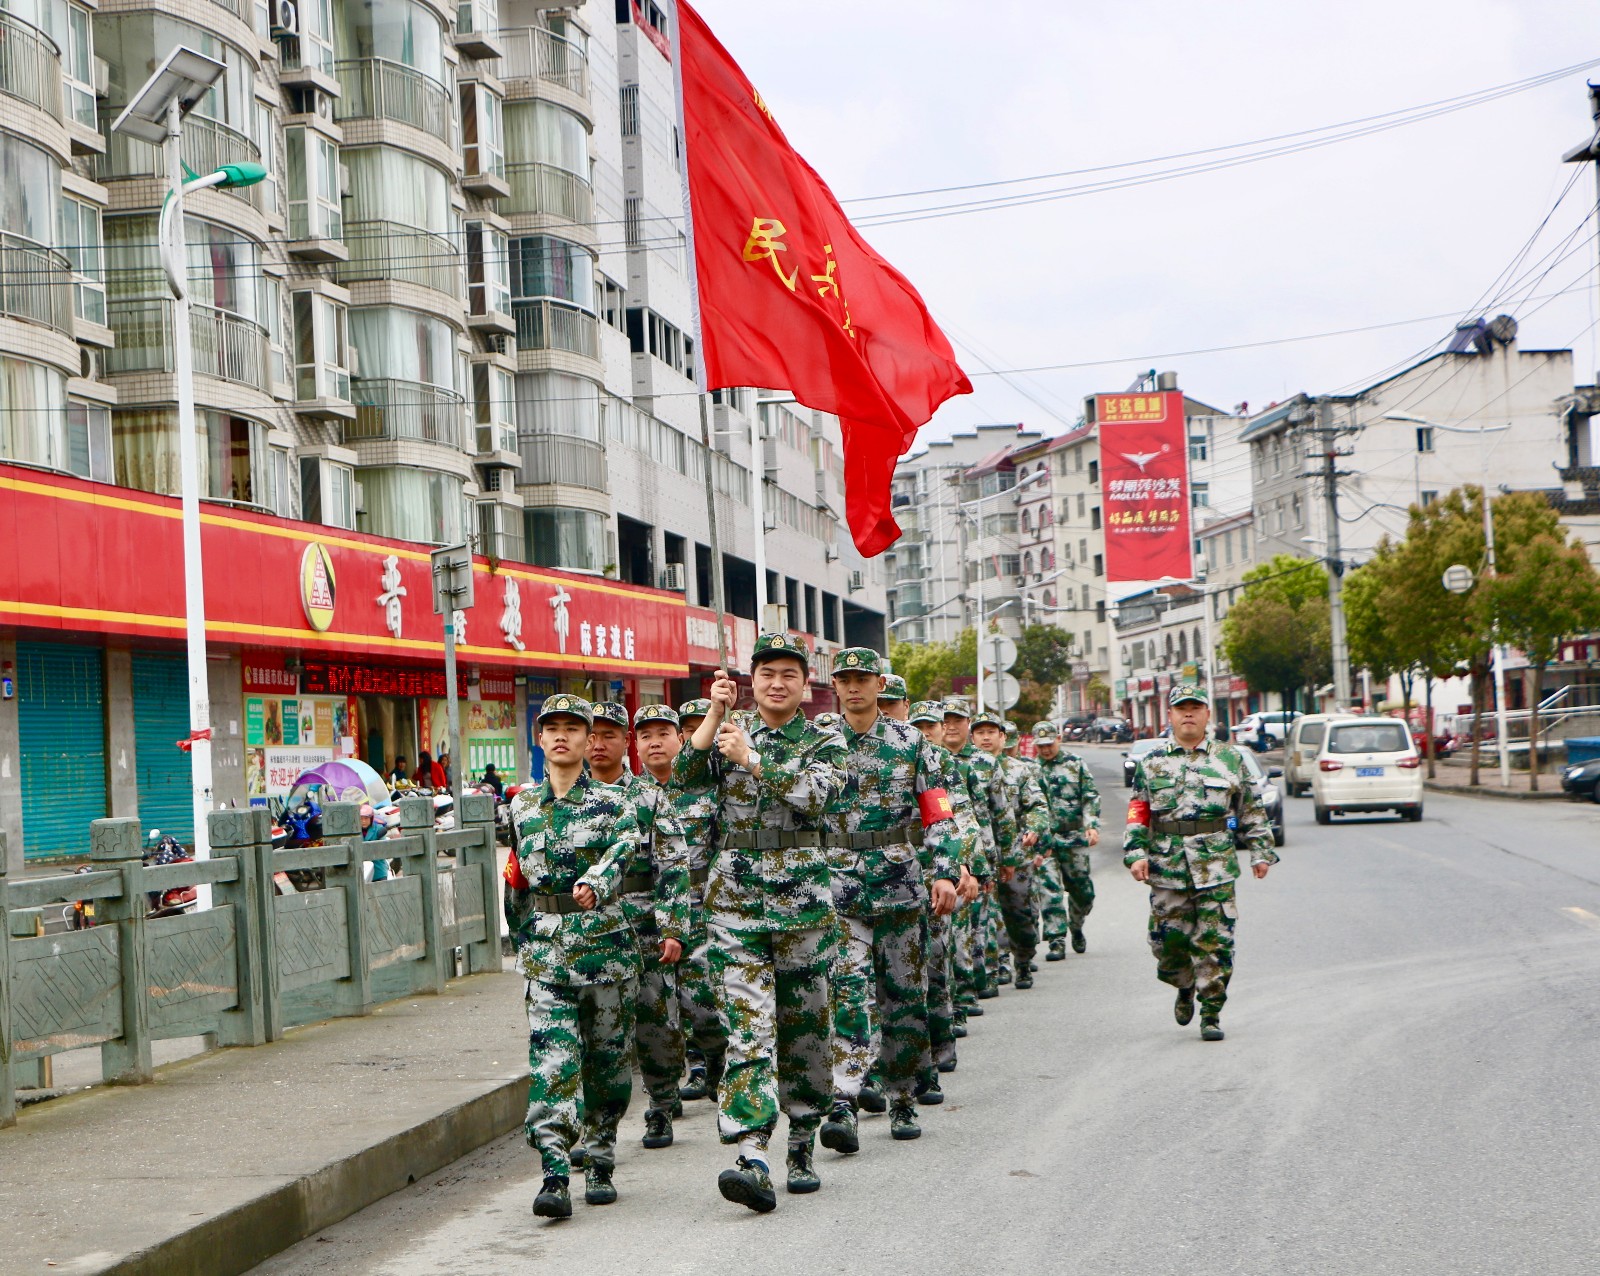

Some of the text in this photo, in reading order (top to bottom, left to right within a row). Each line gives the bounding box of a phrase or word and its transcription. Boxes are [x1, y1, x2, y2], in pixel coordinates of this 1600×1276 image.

[1153, 490, 1181, 499] SOFA
[579, 619, 635, 661] 麻家渡店
